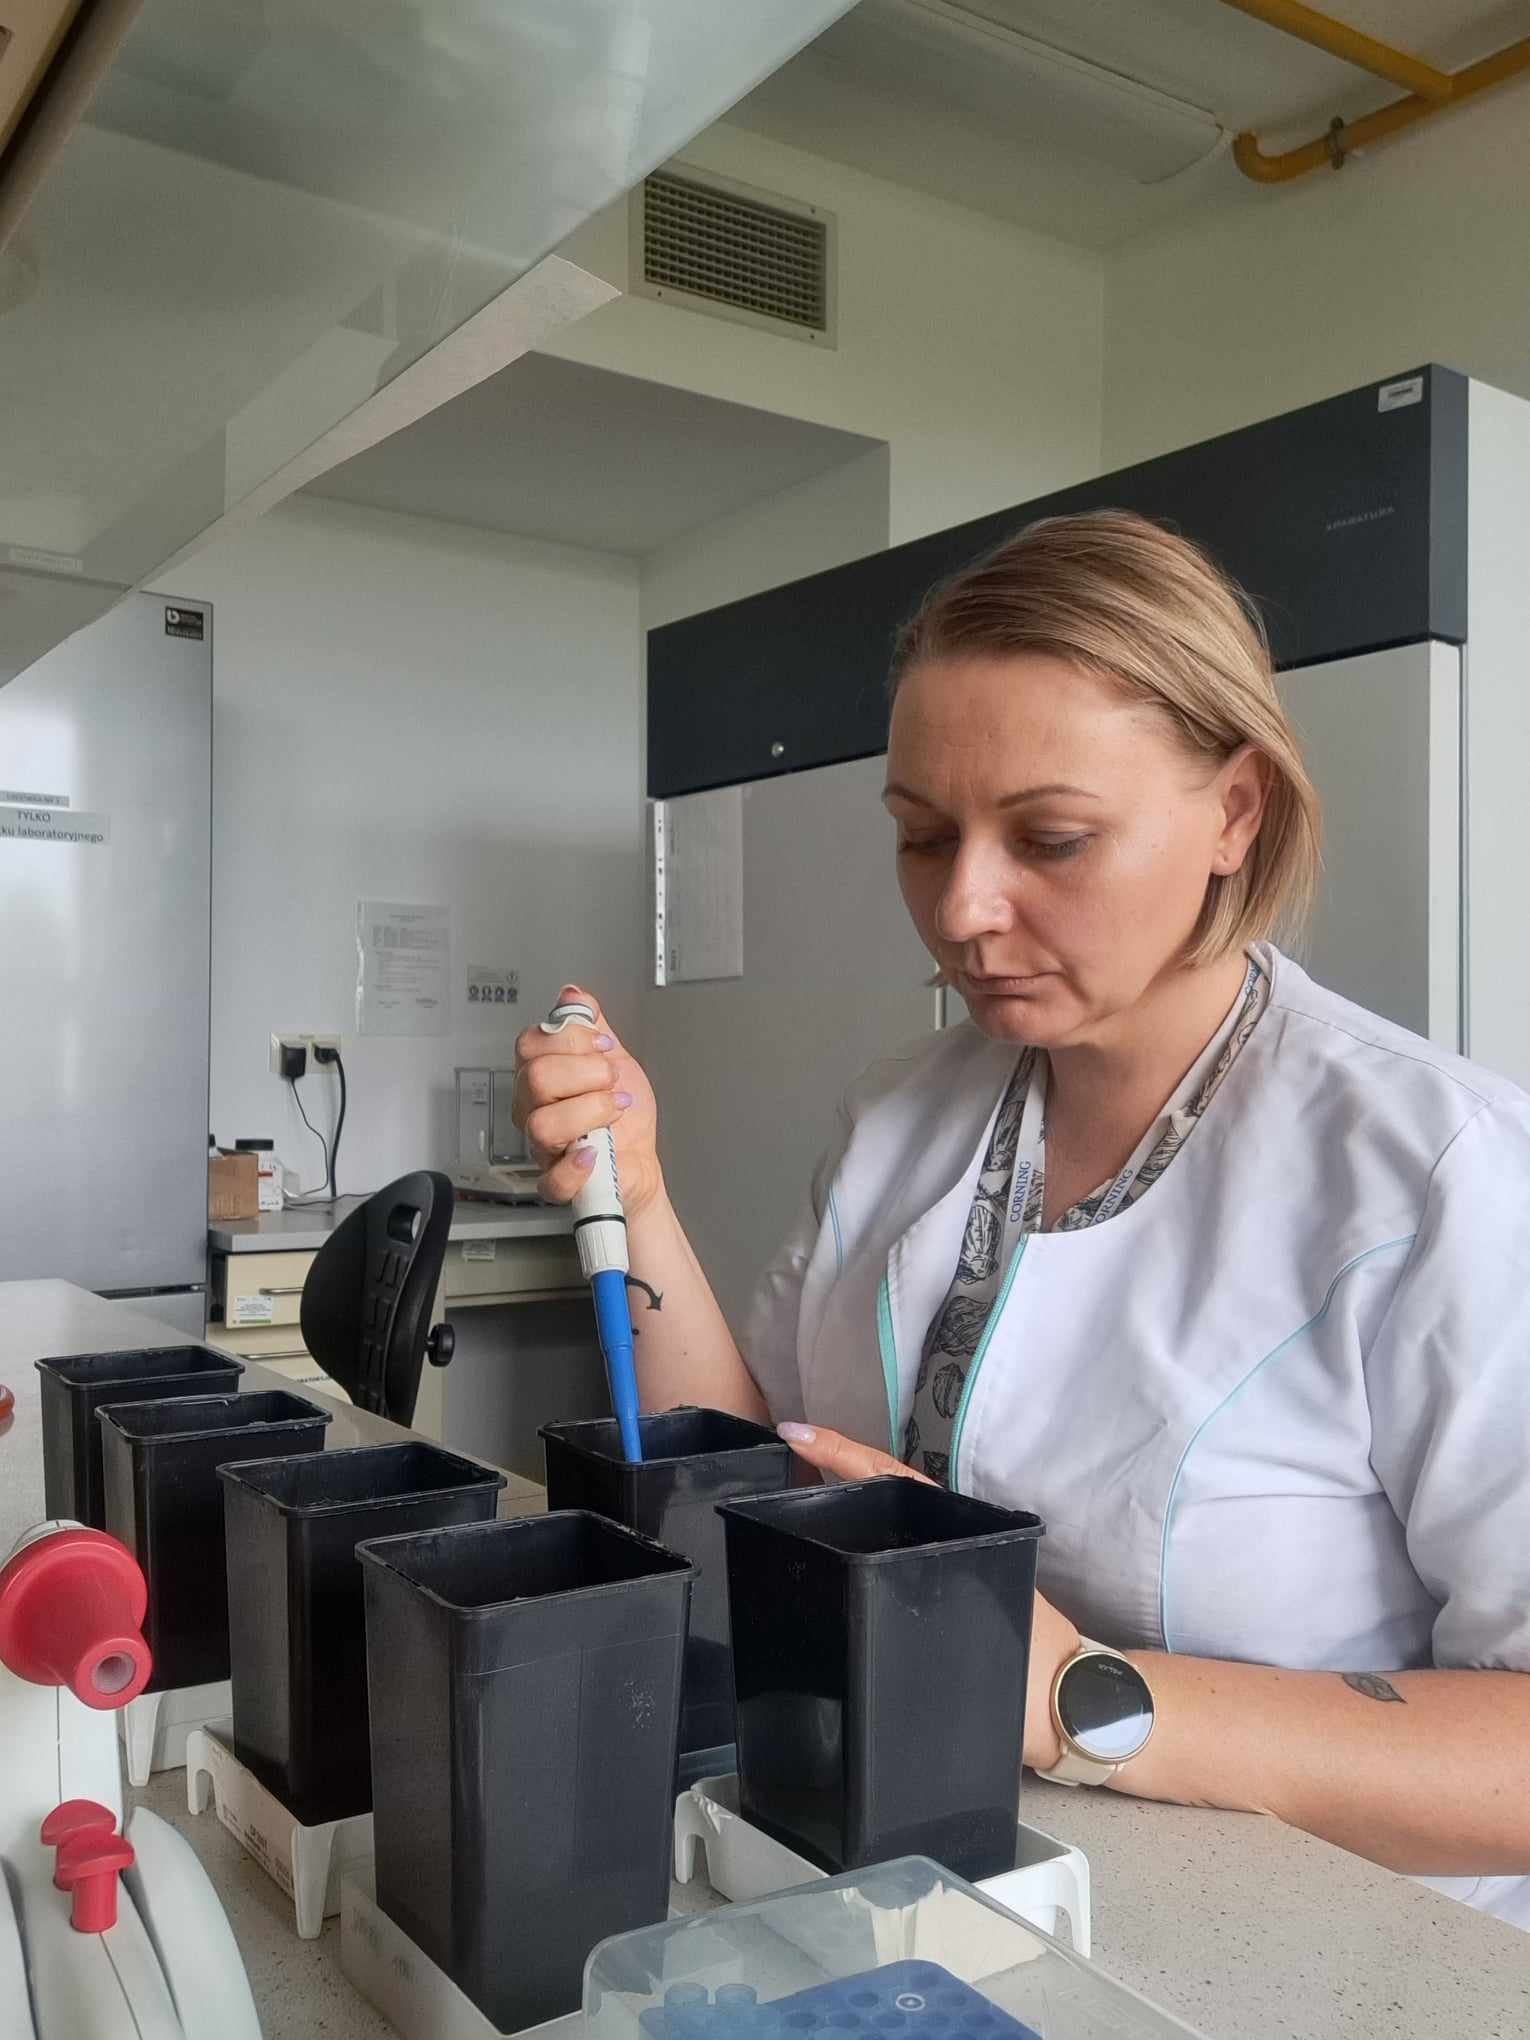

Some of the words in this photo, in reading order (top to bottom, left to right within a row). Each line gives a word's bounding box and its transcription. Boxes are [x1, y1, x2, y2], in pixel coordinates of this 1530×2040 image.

[17, 810, 51, 823] TYLKO
[18, 825, 104, 844] laboratoryjnego
[1010, 1161, 1031, 1222] CORNING
[1094, 1168, 1133, 1223] ORNING
